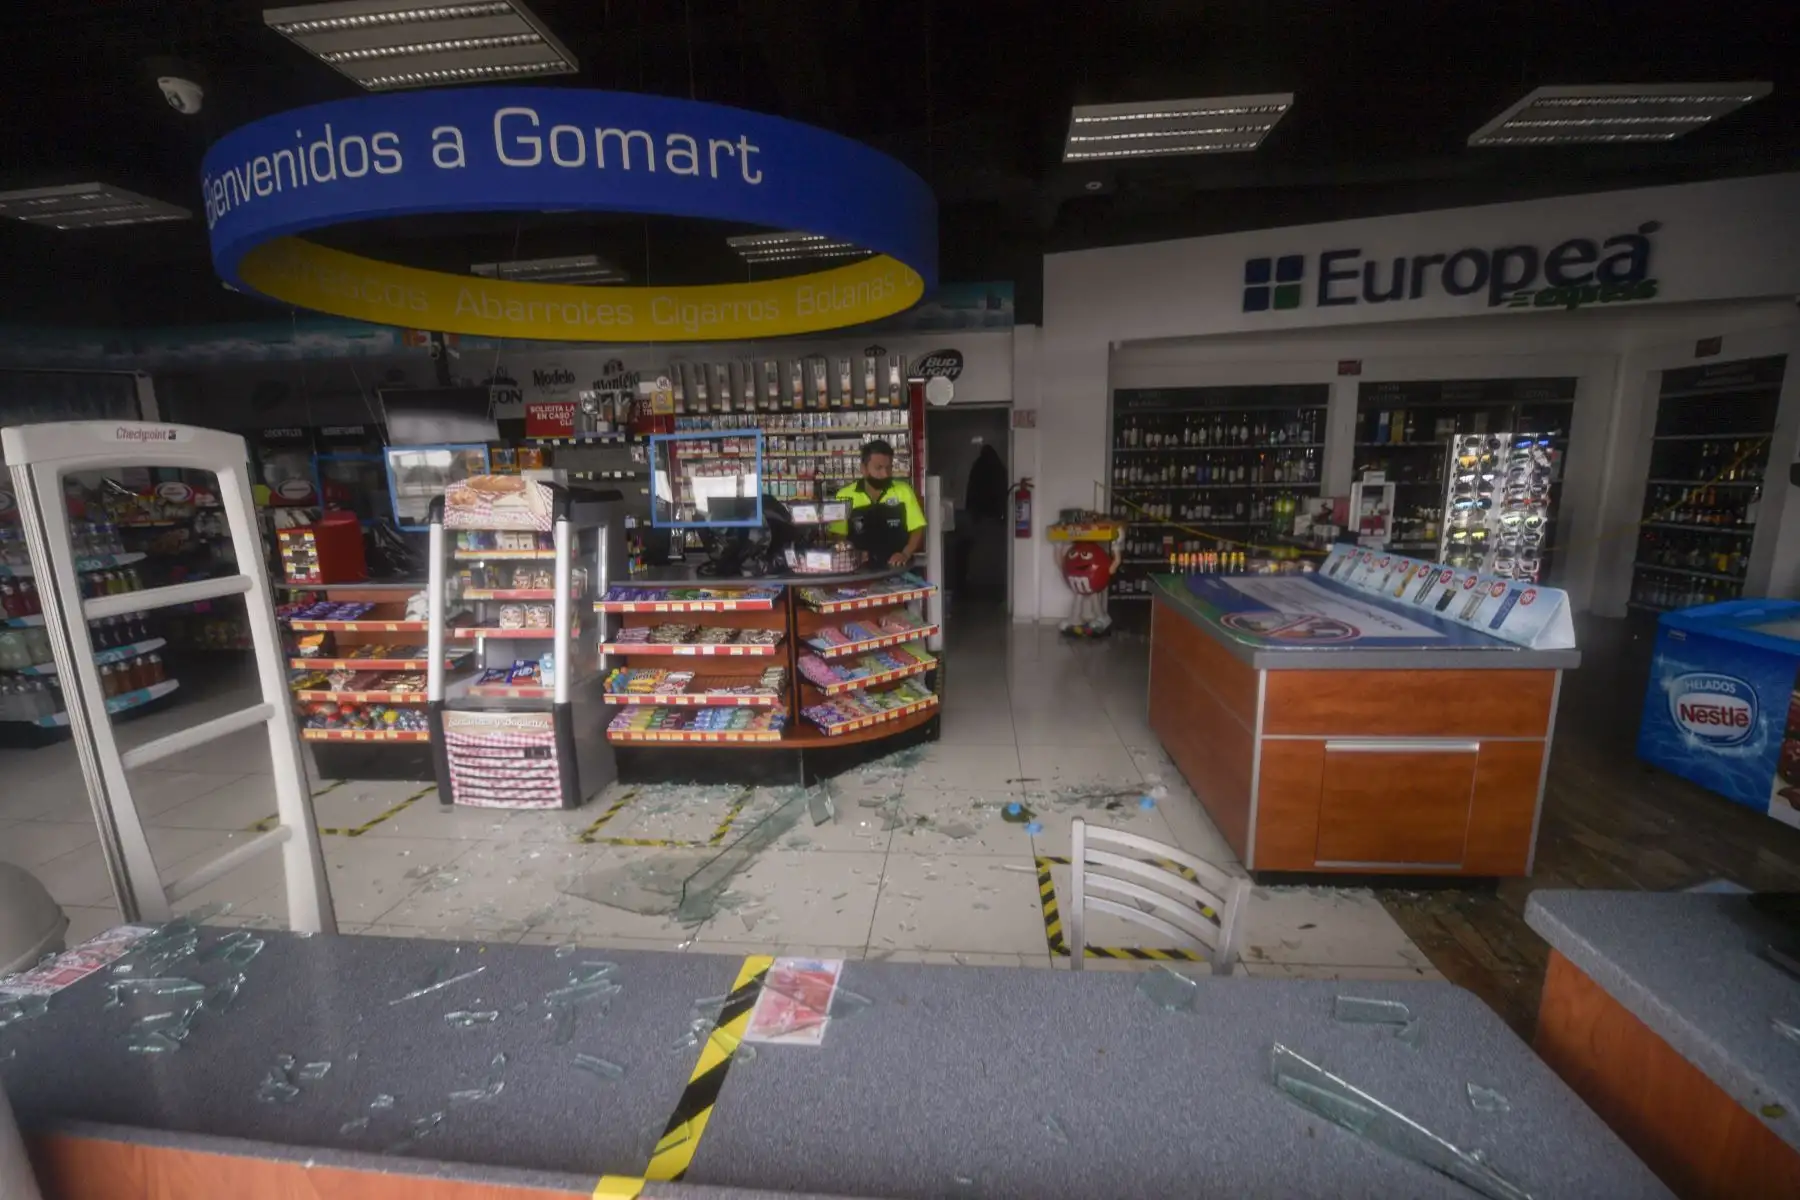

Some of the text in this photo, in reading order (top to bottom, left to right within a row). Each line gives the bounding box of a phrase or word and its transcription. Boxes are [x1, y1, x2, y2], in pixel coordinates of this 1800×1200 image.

[204, 107, 763, 229] Bienvenidos a Gomart
[455, 287, 634, 327] Abarrotes
[652, 295, 779, 333] Cigarros
[796, 272, 896, 317] Botanas
[925, 356, 958, 367] BUD
[532, 369, 576, 387] Modelo
[919, 366, 961, 377] LIGHT
[530, 404, 564, 414] SOLICITA
[116, 426, 167, 443] Checkpoint
[1684, 679, 1737, 695] HELADOS
[1680, 703, 1750, 728] Nestlé
